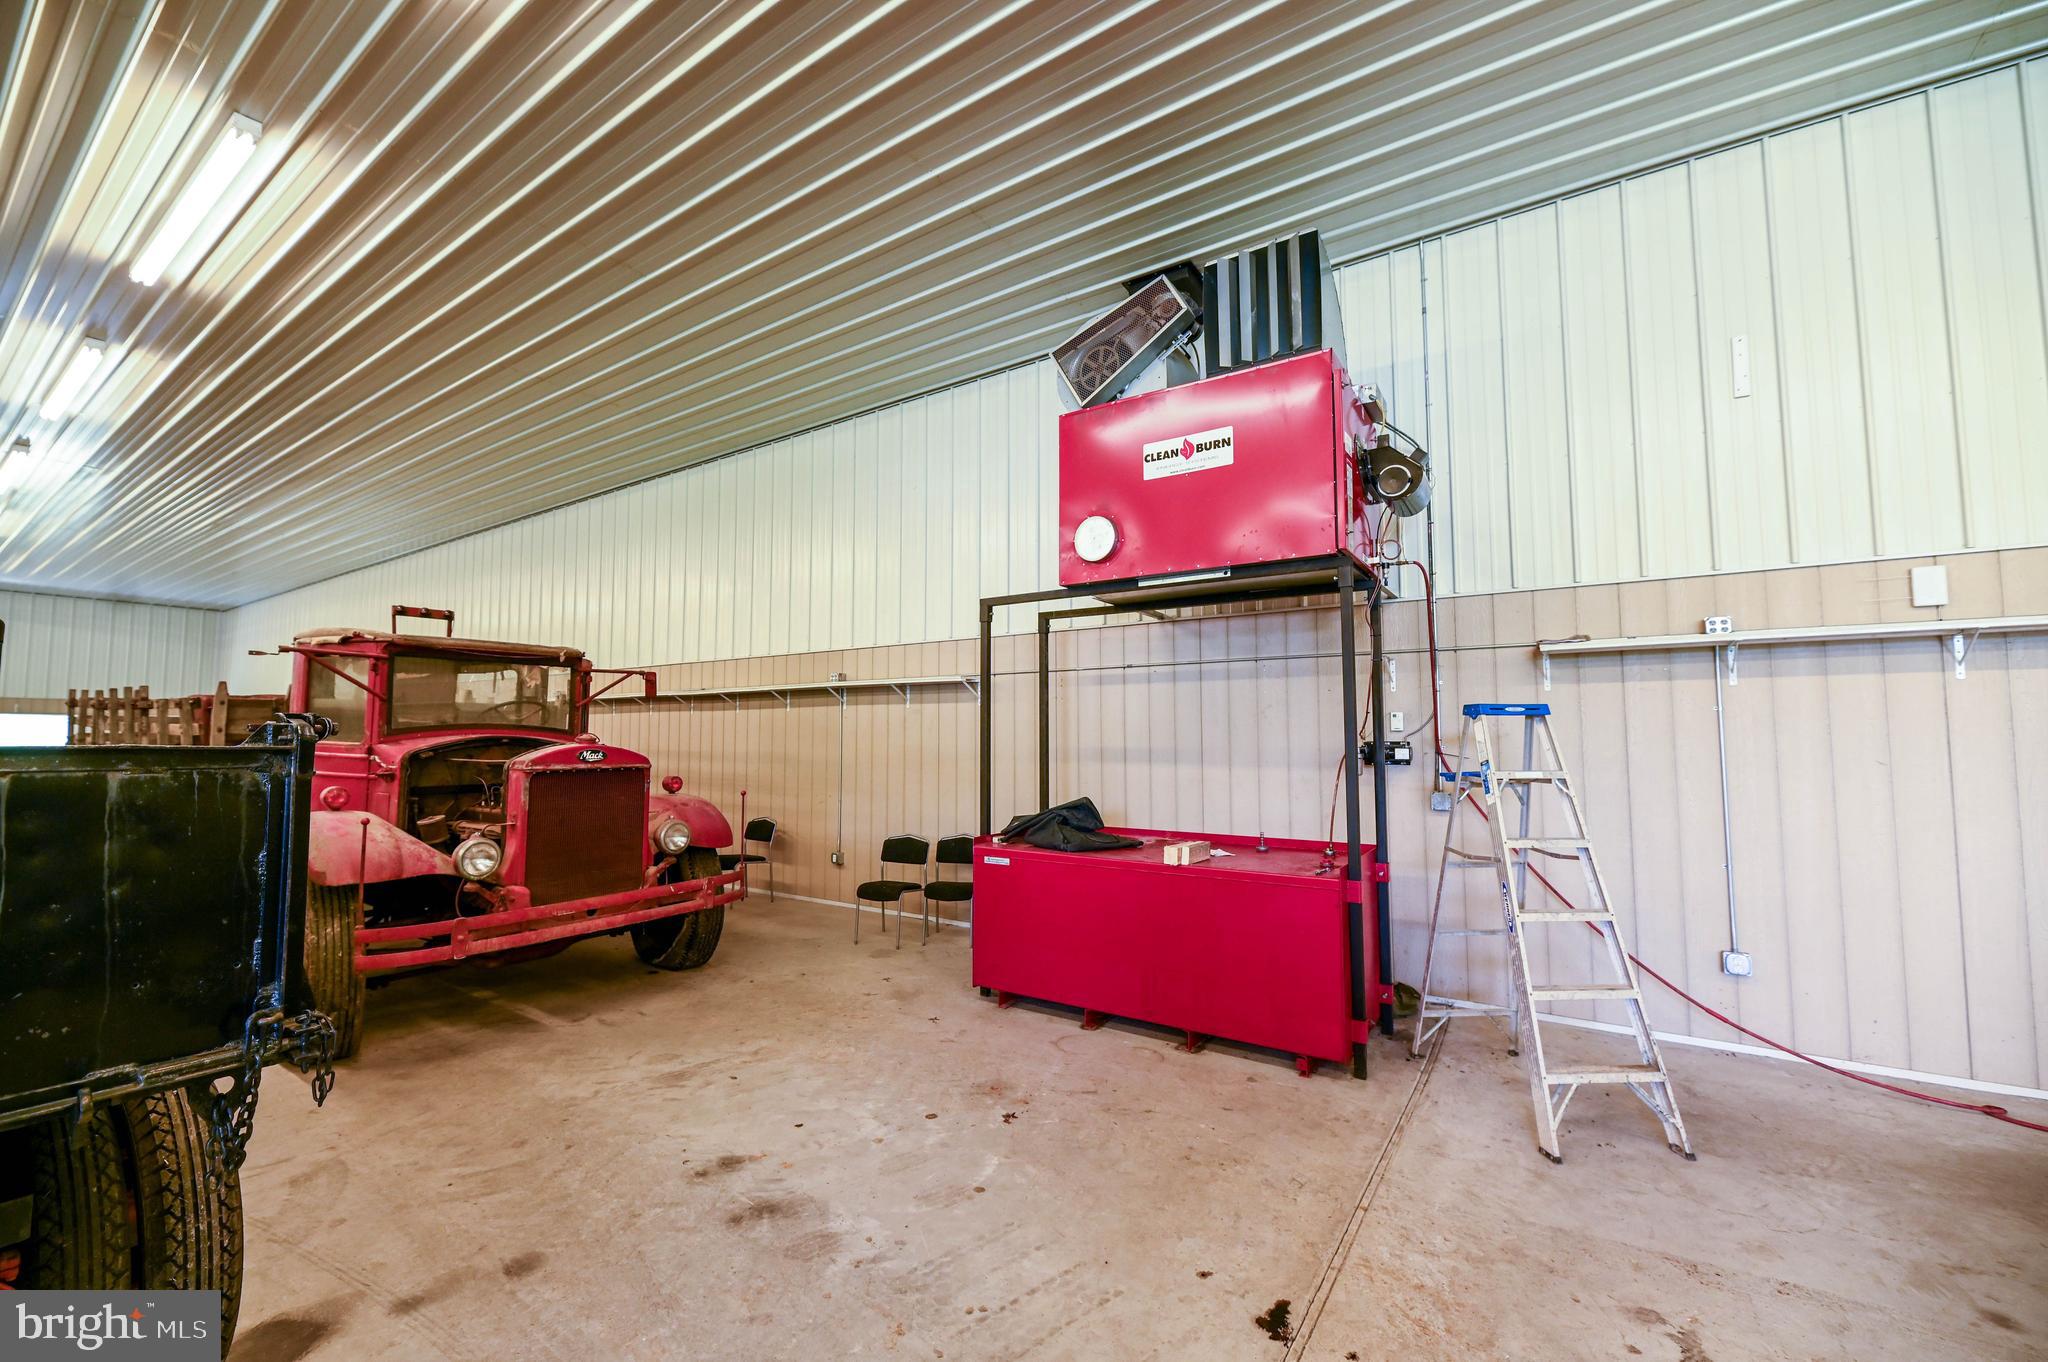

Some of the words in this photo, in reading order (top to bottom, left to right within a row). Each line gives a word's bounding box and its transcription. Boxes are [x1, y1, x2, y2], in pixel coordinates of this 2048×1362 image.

[1144, 448, 1179, 463] CLEAN
[1196, 437, 1231, 453] BURN
[580, 750, 604, 760] Mack
